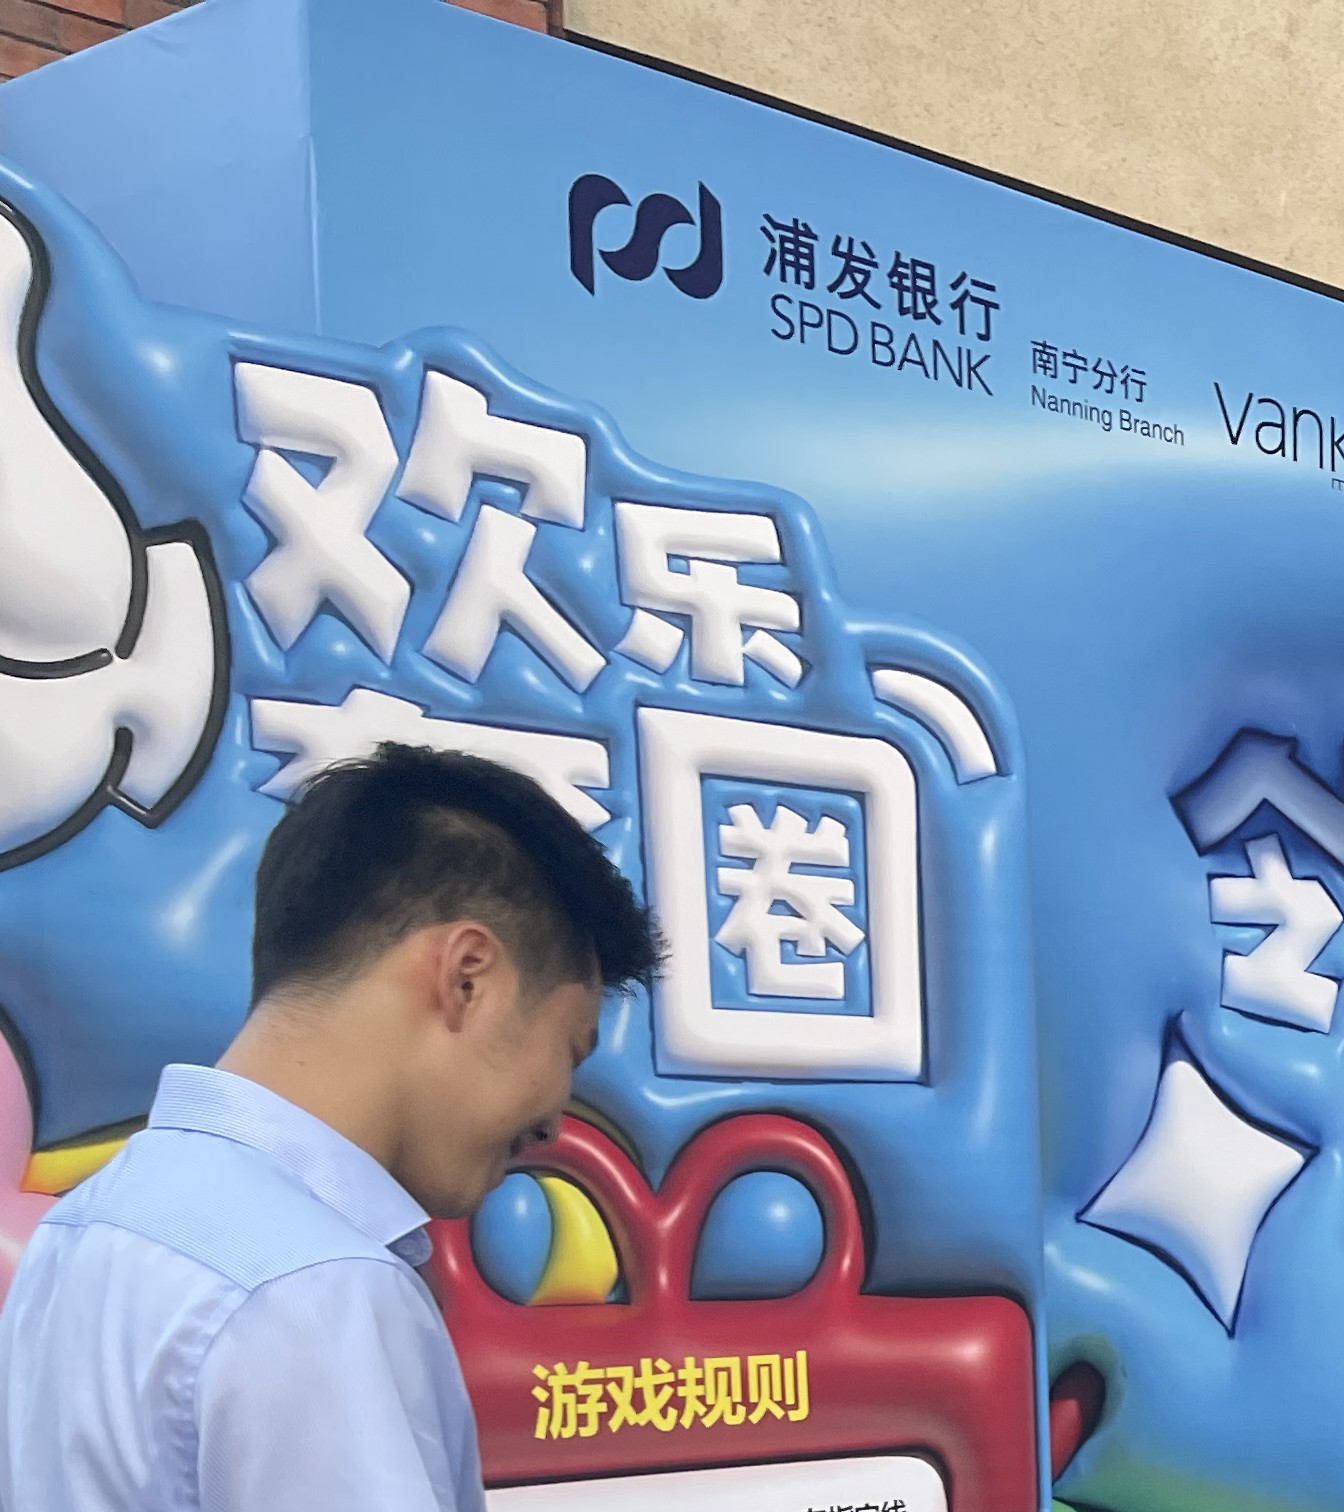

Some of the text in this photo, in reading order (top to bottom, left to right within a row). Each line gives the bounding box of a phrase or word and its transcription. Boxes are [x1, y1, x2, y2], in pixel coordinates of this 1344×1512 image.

[759, 212, 1001, 342] 浦发银行
[770, 293, 994, 397] SPD BANK
[1030, 340, 1148, 403] 南宁分行
[1030, 384, 1185, 447] Nanning Branch
[231, 360, 803, 695] 欢乐
[531, 1350, 810, 1441] 游戏规则
